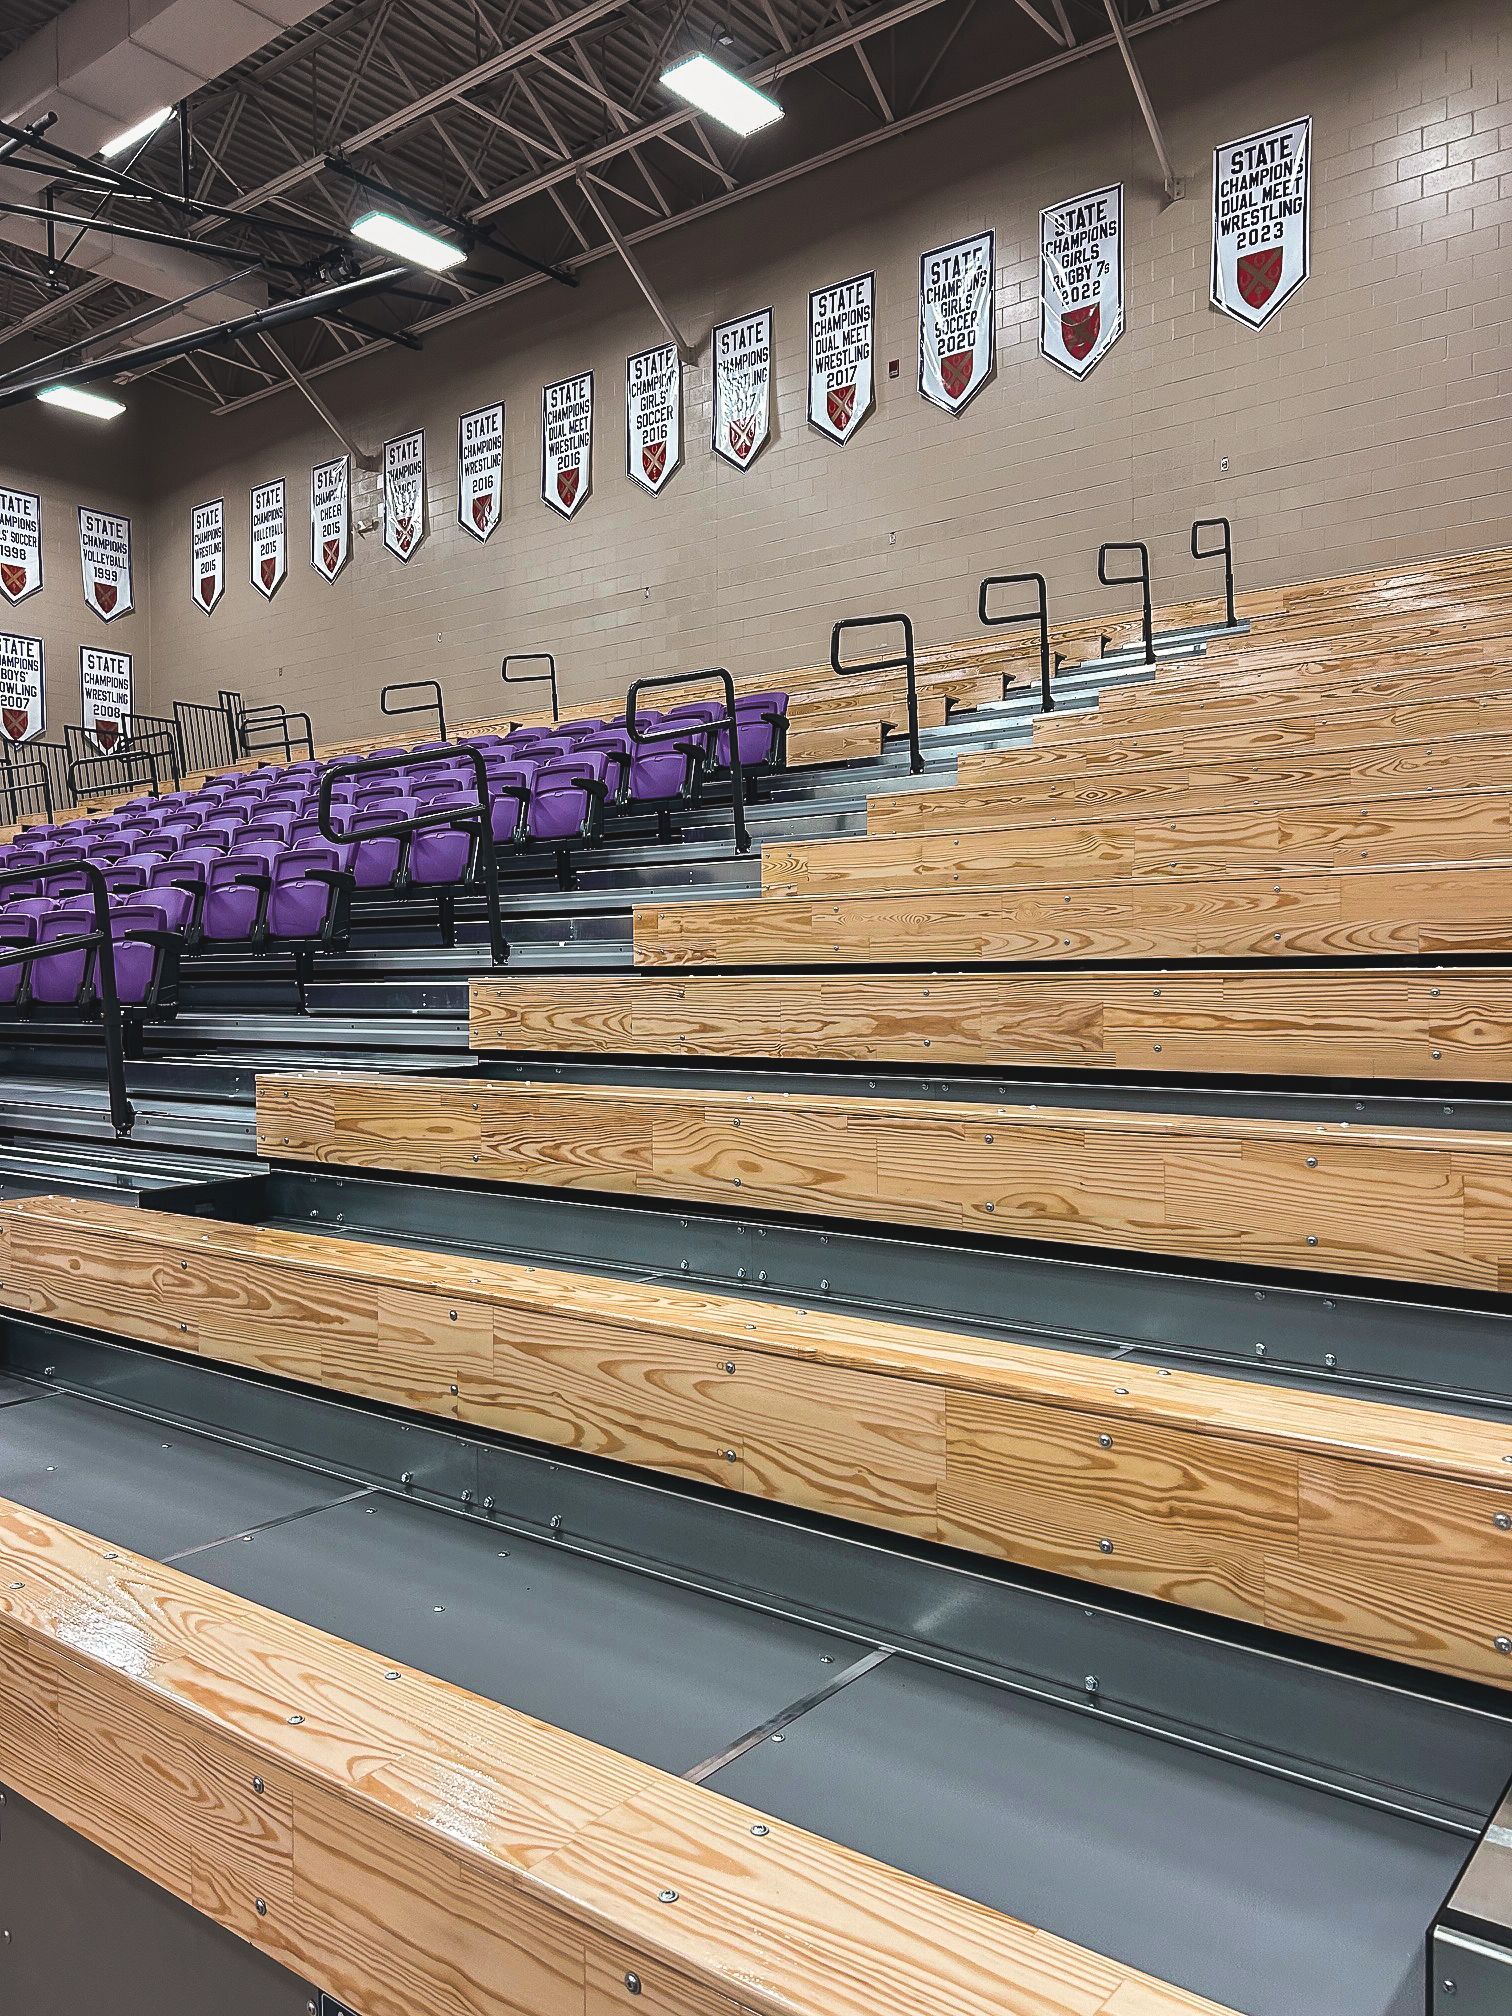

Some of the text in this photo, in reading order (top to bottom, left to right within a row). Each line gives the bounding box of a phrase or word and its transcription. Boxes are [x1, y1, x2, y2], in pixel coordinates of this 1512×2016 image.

[1231, 134, 1293, 174] STATE
[1221, 158, 1303, 198] CHAMPIONS
[1222, 176, 1302, 217] DUAL MEET
[1055, 199, 1107, 237] STATE
[1221, 197, 1302, 236] WRESTLING
[1046, 220, 1116, 257] CHAMPIONS
[1237, 221, 1283, 250] 2023
[1062, 244, 1099, 268] GIRLS
[819, 282, 865, 318] STATE
[1062, 280, 1101, 306] 2022
[941, 294, 972, 318] GIRLS
[815, 305, 870, 338] CHAMPIONS
[935, 310, 979, 338] SOCCER
[722, 321, 764, 355] STATE
[816, 325, 869, 356] DUAL MEET
[938, 330, 976, 356] 2020
[635, 348, 674, 380] STATE
[815, 343, 870, 374] WRESTLING
[827, 365, 857, 389] 2017
[551, 379, 586, 408] STATE
[548, 399, 590, 425] CHAMPIONS
[637, 405, 673, 430] SOCCER
[467, 413, 498, 440] STATE
[549, 416, 589, 441] DUAL MEET
[643, 424, 668, 445] 2016
[390, 439, 419, 465] STATE
[464, 435, 502, 459] CHAMPIONS
[549, 432, 590, 458] WRESTLING
[465, 453, 502, 476] WRESTLING
[558, 451, 580, 471] 2016
[473, 475, 494, 493] 2016
[0, 494, 31, 516] TATE
[256, 487, 280, 510] STATE
[316, 487, 346, 507] CHAMP
[0, 513, 37, 532] AMPIONS
[197, 508, 219, 529] STATE
[254, 507, 283, 527] CHAMPIONS
[321, 504, 342, 521] CHEER
[87, 516, 123, 539] STATE
[195, 527, 222, 546] CHAMPIONS
[254, 523, 284, 542] VOLLEYBALL
[323, 521, 340, 537] 2015
[11, 532, 37, 548] SOCCER
[83, 534, 128, 554] CHAMPIONS
[195, 542, 222, 560] WRESTLING
[261, 541, 277, 556] 2015
[0, 545, 26, 560] 1998
[83, 549, 127, 570] VOLLEYBALL
[94, 567, 118, 582] 1999
[201, 559, 216, 574] 2015
[0, 638, 34, 658] TATE
[0, 655, 39, 671] AMPIONS
[88, 654, 125, 675] STATE
[0, 681, 37, 698] OWLING
[84, 673, 129, 690] CHAMPIONS
[1, 695, 30, 709] 2007
[85, 688, 128, 705] WRESTLING
[94, 704, 121, 719] 2008
